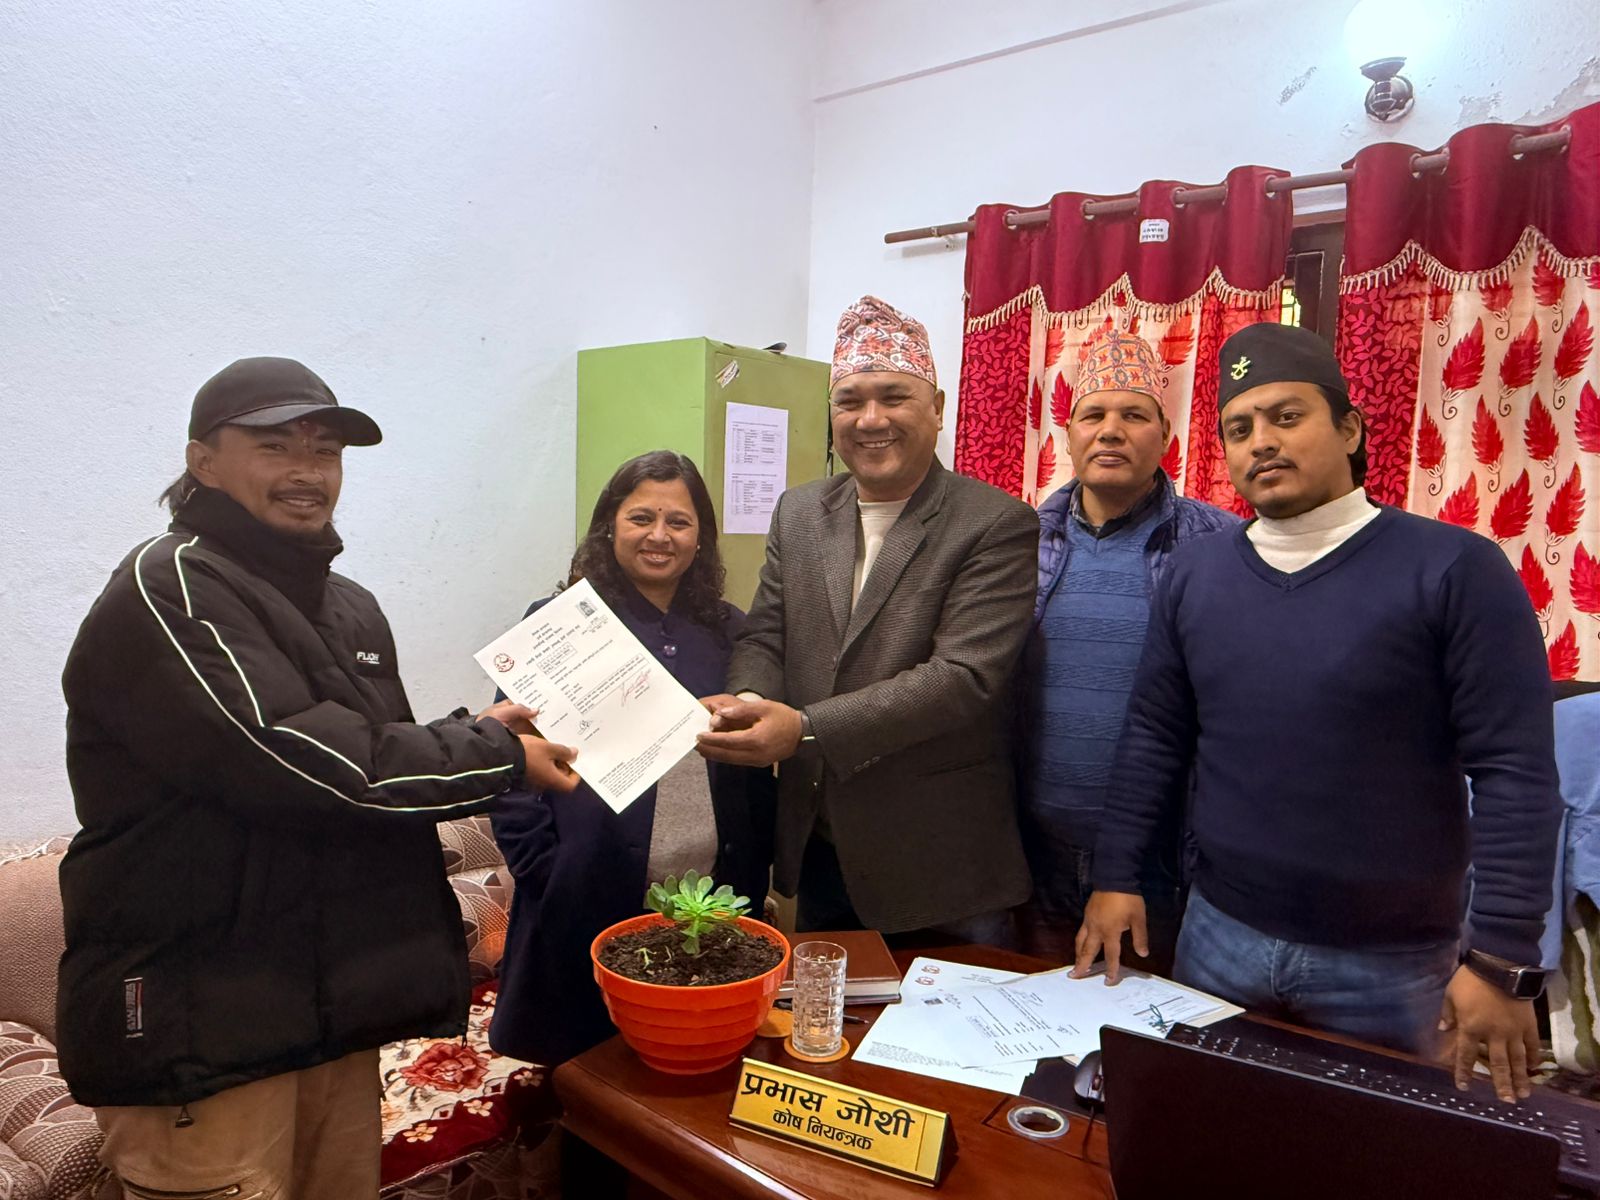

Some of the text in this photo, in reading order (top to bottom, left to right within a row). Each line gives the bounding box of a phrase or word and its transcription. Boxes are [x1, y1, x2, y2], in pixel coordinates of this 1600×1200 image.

[741, 1073, 915, 1138] प्रभास जोशी
[772, 1109, 874, 1150] कोष नियन्त्रक
